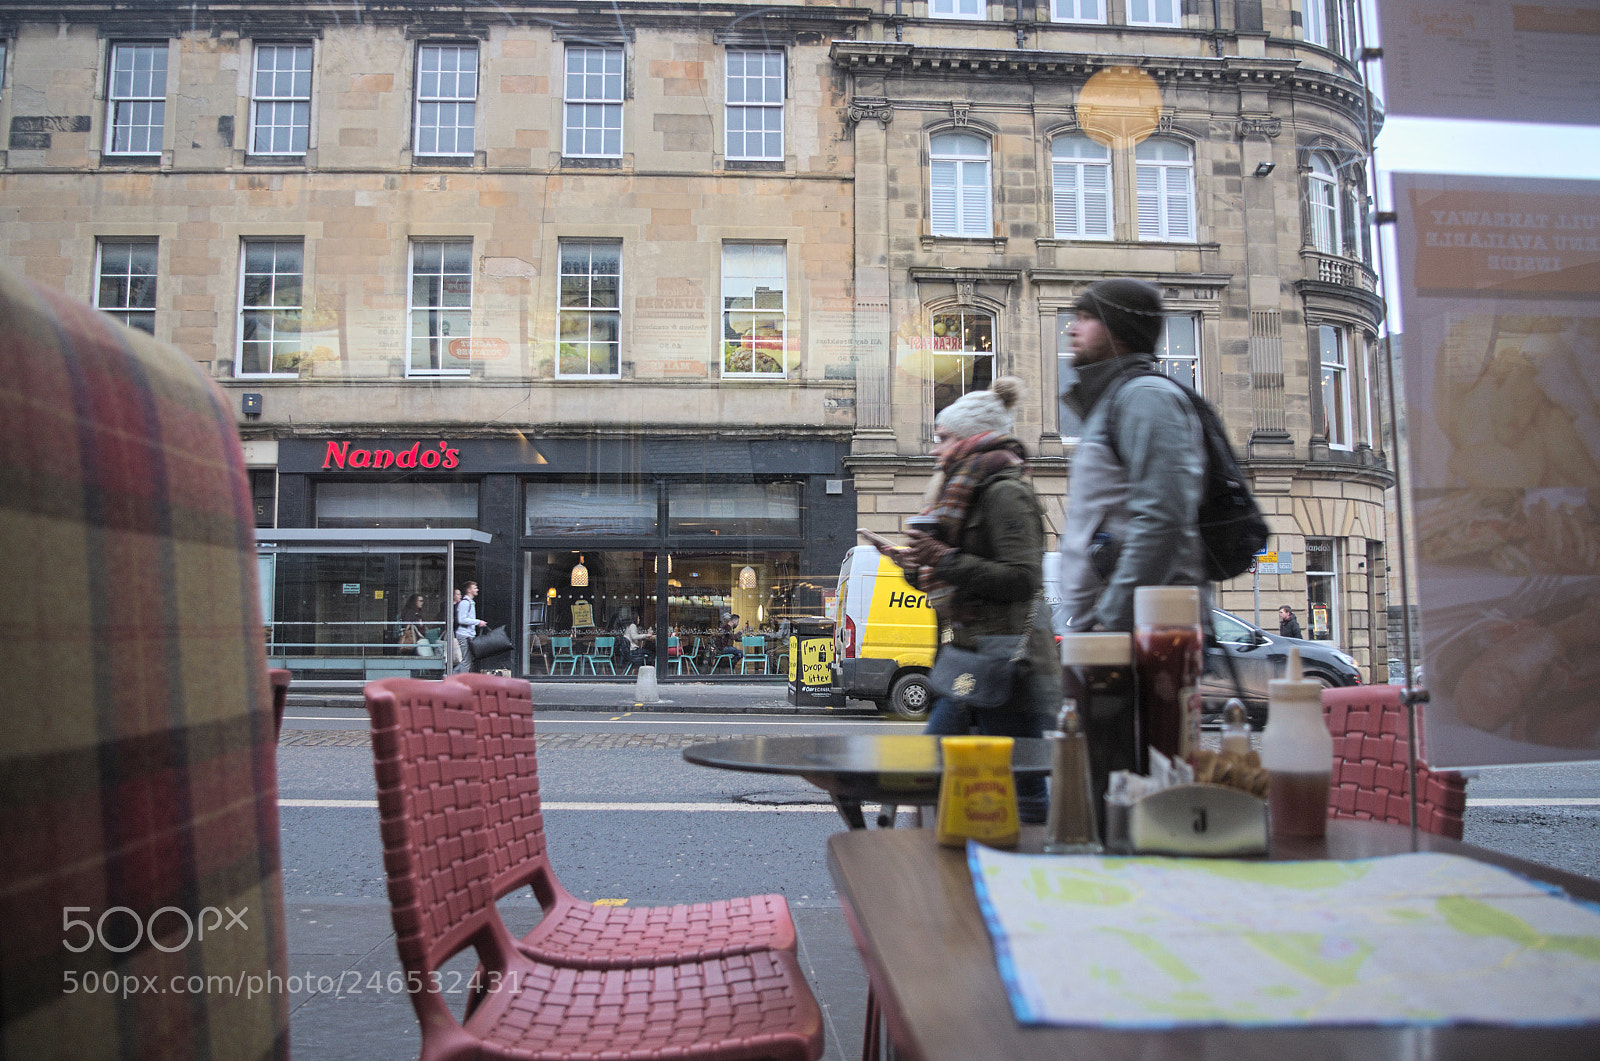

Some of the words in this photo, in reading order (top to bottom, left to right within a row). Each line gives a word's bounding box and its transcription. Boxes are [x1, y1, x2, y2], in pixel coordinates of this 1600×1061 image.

[322, 441, 460, 469] Nando's
[257, 505, 264, 515] 5
[803, 664, 823, 673] Drop
[808, 673, 829, 683] litter
